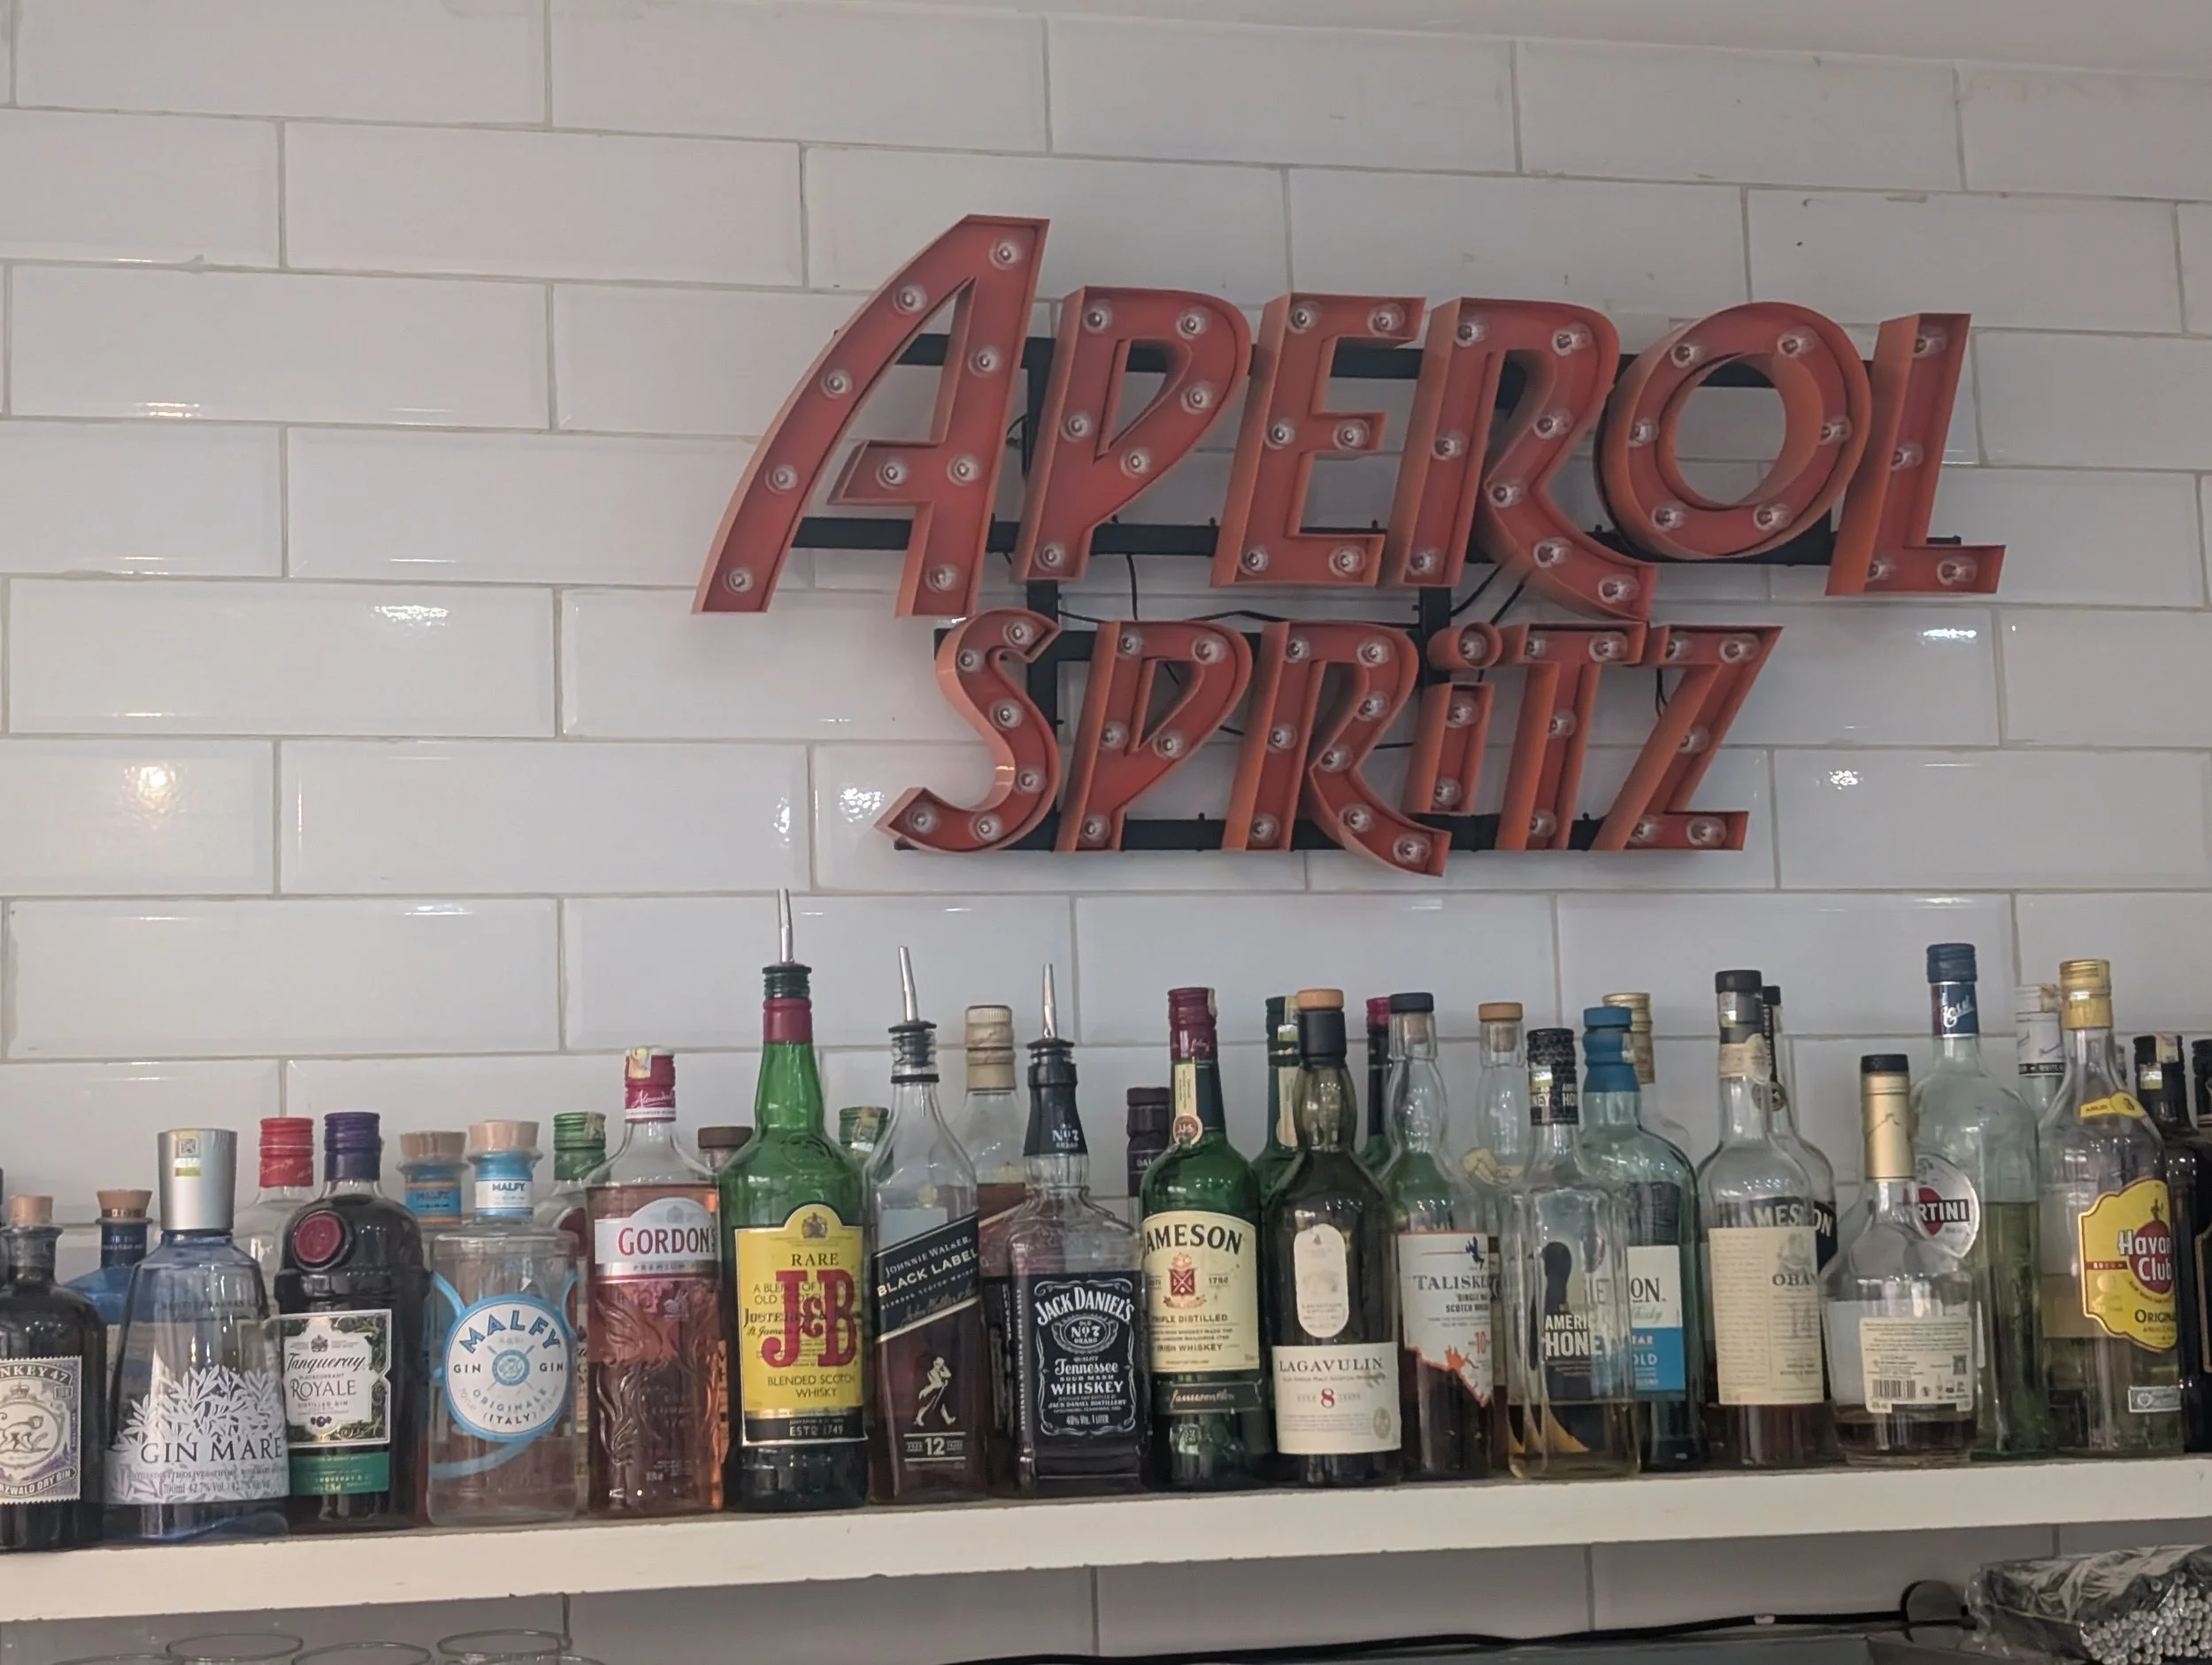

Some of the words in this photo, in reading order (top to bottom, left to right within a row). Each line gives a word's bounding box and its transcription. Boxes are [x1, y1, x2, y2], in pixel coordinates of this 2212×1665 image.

[692, 214, 2007, 618] APEROL
[493, 1183, 526, 1192] MALFY
[791, 1253, 839, 1266] RARE
[885, 1253, 928, 1278] JOHNNIE
[928, 1235, 969, 1257] WALKER
[877, 1268, 928, 1297] BLACK
[931, 1247, 978, 1274] LABEL
[2138, 1257, 2173, 1281] Club
[1034, 1292, 1073, 1326] JACK
[1073, 1286, 1135, 1325] DANIEL'S
[1446, 1303, 1472, 1313] SCOTCH
[761, 1268, 856, 1369] J&B
[1179, 1313, 1228, 1323] DISTILLED
[458, 1309, 561, 1354] MALFY
[1179, 1343, 1223, 1352] WHISKEY
[1475, 1331, 1486, 1354] 10
[286, 1352, 366, 1374] Tanqueray
[453, 1363, 481, 1374] GIN
[539, 1362, 565, 1372] GIN
[1054, 1358, 1118, 1376] Tennessee
[1279, 1357, 1385, 1373] LAGAVULIN
[50, 1371, 68, 1383] 47
[768, 1375, 817, 1386] BLENDED
[289, 1377, 357, 1401] ROYALE
[795, 1387, 837, 1398] WHISKY
[1050, 1380, 1125, 1395] WHISKEY
[472, 1388, 548, 1412] ORIGINALE
[1320, 1387, 1335, 1409] 8
[823, 1424, 844, 1435] 1749
[141, 1442, 198, 1463] GIN
[210, 1436, 283, 1462] MARE
[925, 1438, 946, 1456] 12
[56, 1469, 71, 1483] GIN
